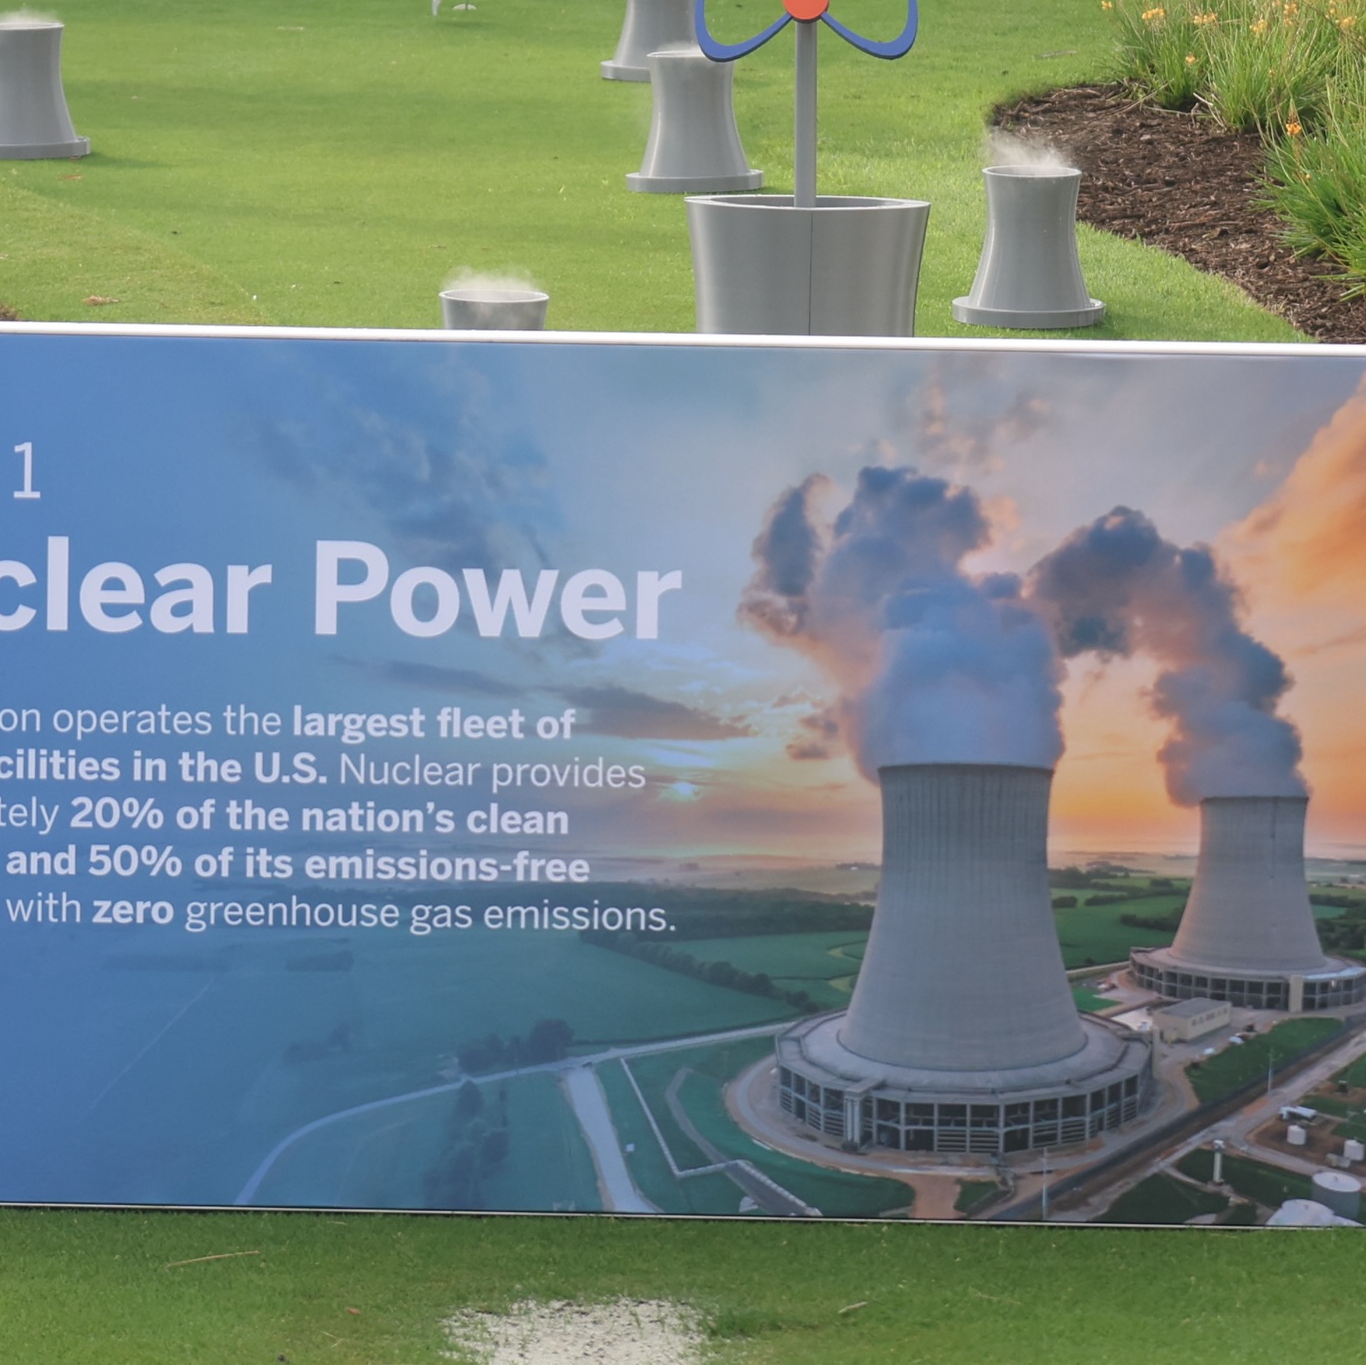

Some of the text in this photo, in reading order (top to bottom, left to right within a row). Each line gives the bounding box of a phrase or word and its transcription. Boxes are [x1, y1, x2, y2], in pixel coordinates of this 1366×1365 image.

[13, 441, 41, 500] 1
[314, 539, 682, 640] Power
[52, 703, 213, 741] operates
[222, 703, 282, 736] the
[293, 704, 426, 745] largest
[436, 707, 525, 739] fleet
[536, 708, 576, 740] of
[133, 750, 167, 782] in
[178, 750, 242, 783] the
[254, 751, 328, 784] U.S.
[340, 752, 481, 786] Nuclear
[492, 756, 646, 794] provides
[69, 796, 165, 830] 20%
[175, 798, 216, 830] of
[225, 799, 290, 832] the
[301, 800, 456, 834] nation’s
[466, 802, 569, 835] clean
[5, 843, 77, 876] and
[88, 844, 183, 878] 50%
[194, 846, 235, 878] of
[245, 846, 294, 879] its
[304, 848, 590, 883] emissions-free
[5, 891, 81, 923] with
[91, 900, 175, 925] zero
[184, 894, 400, 933] greenhouse
[409, 904, 473, 936] gas
[483, 898, 676, 932] emissions.
